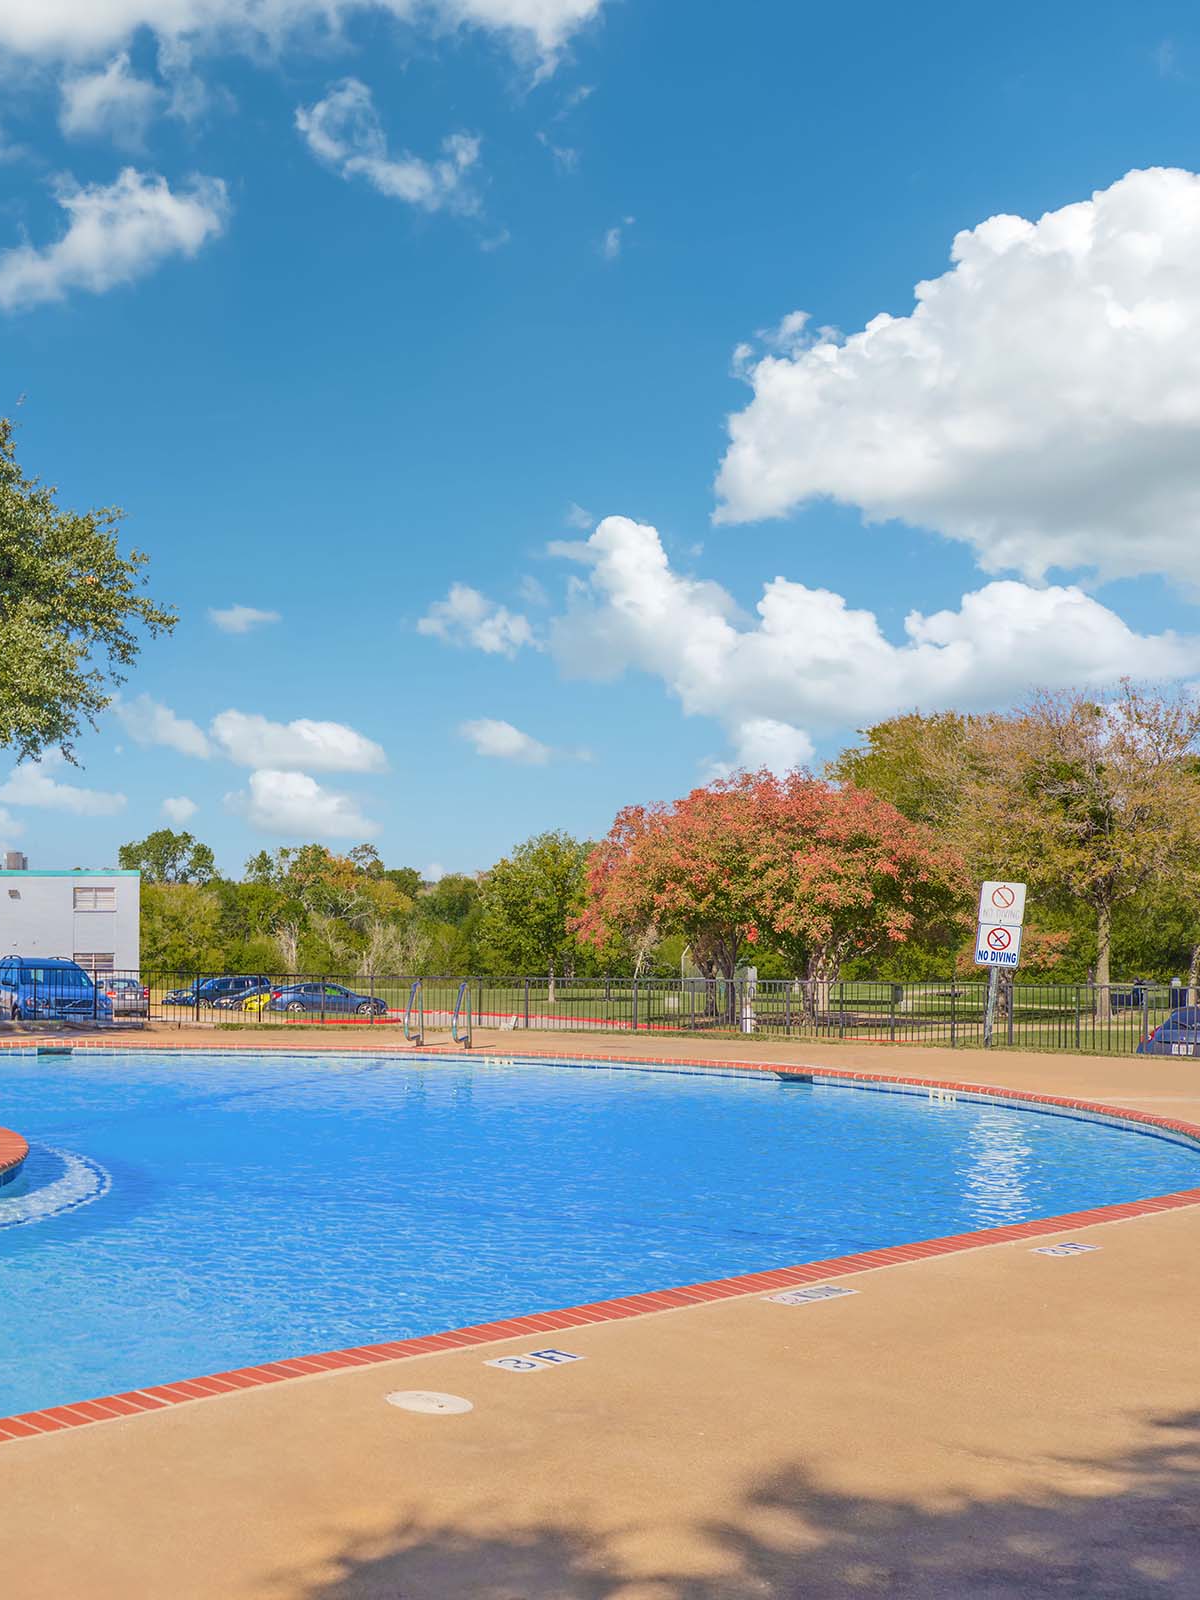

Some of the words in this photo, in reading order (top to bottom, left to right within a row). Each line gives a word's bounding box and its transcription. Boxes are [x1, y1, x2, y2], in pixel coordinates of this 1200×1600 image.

[978, 950, 988, 961] NO
[991, 951, 1017, 964] DIVING
[498, 1358, 537, 1370] 3
[529, 1349, 578, 1363] FT
